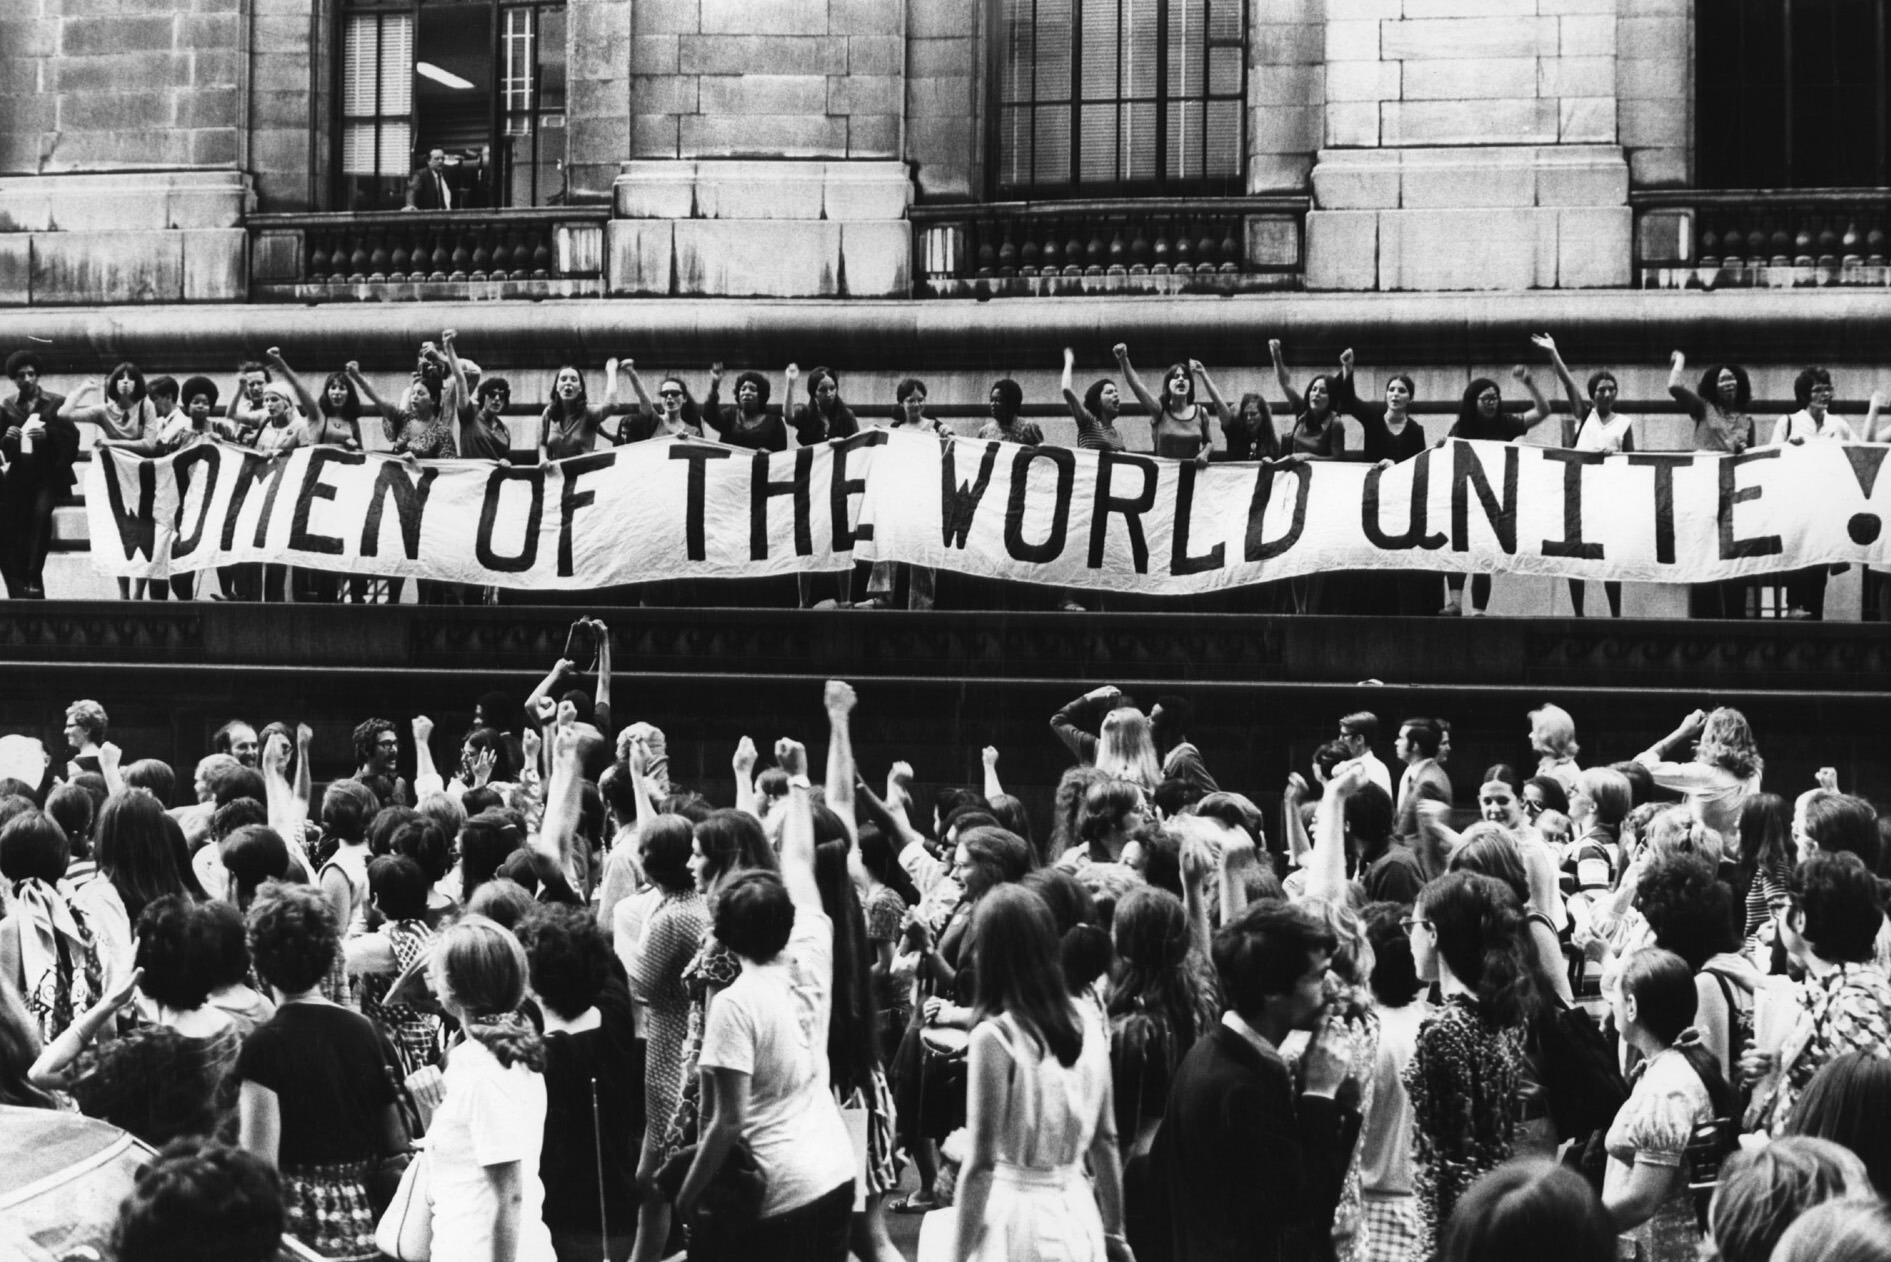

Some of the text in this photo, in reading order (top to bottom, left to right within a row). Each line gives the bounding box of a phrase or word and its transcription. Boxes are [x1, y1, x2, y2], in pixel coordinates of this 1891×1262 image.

[100, 442, 439, 562] WOMEN
[475, 450, 617, 577] OF
[668, 430, 889, 561] THE
[940, 440, 1313, 576] WORLD
